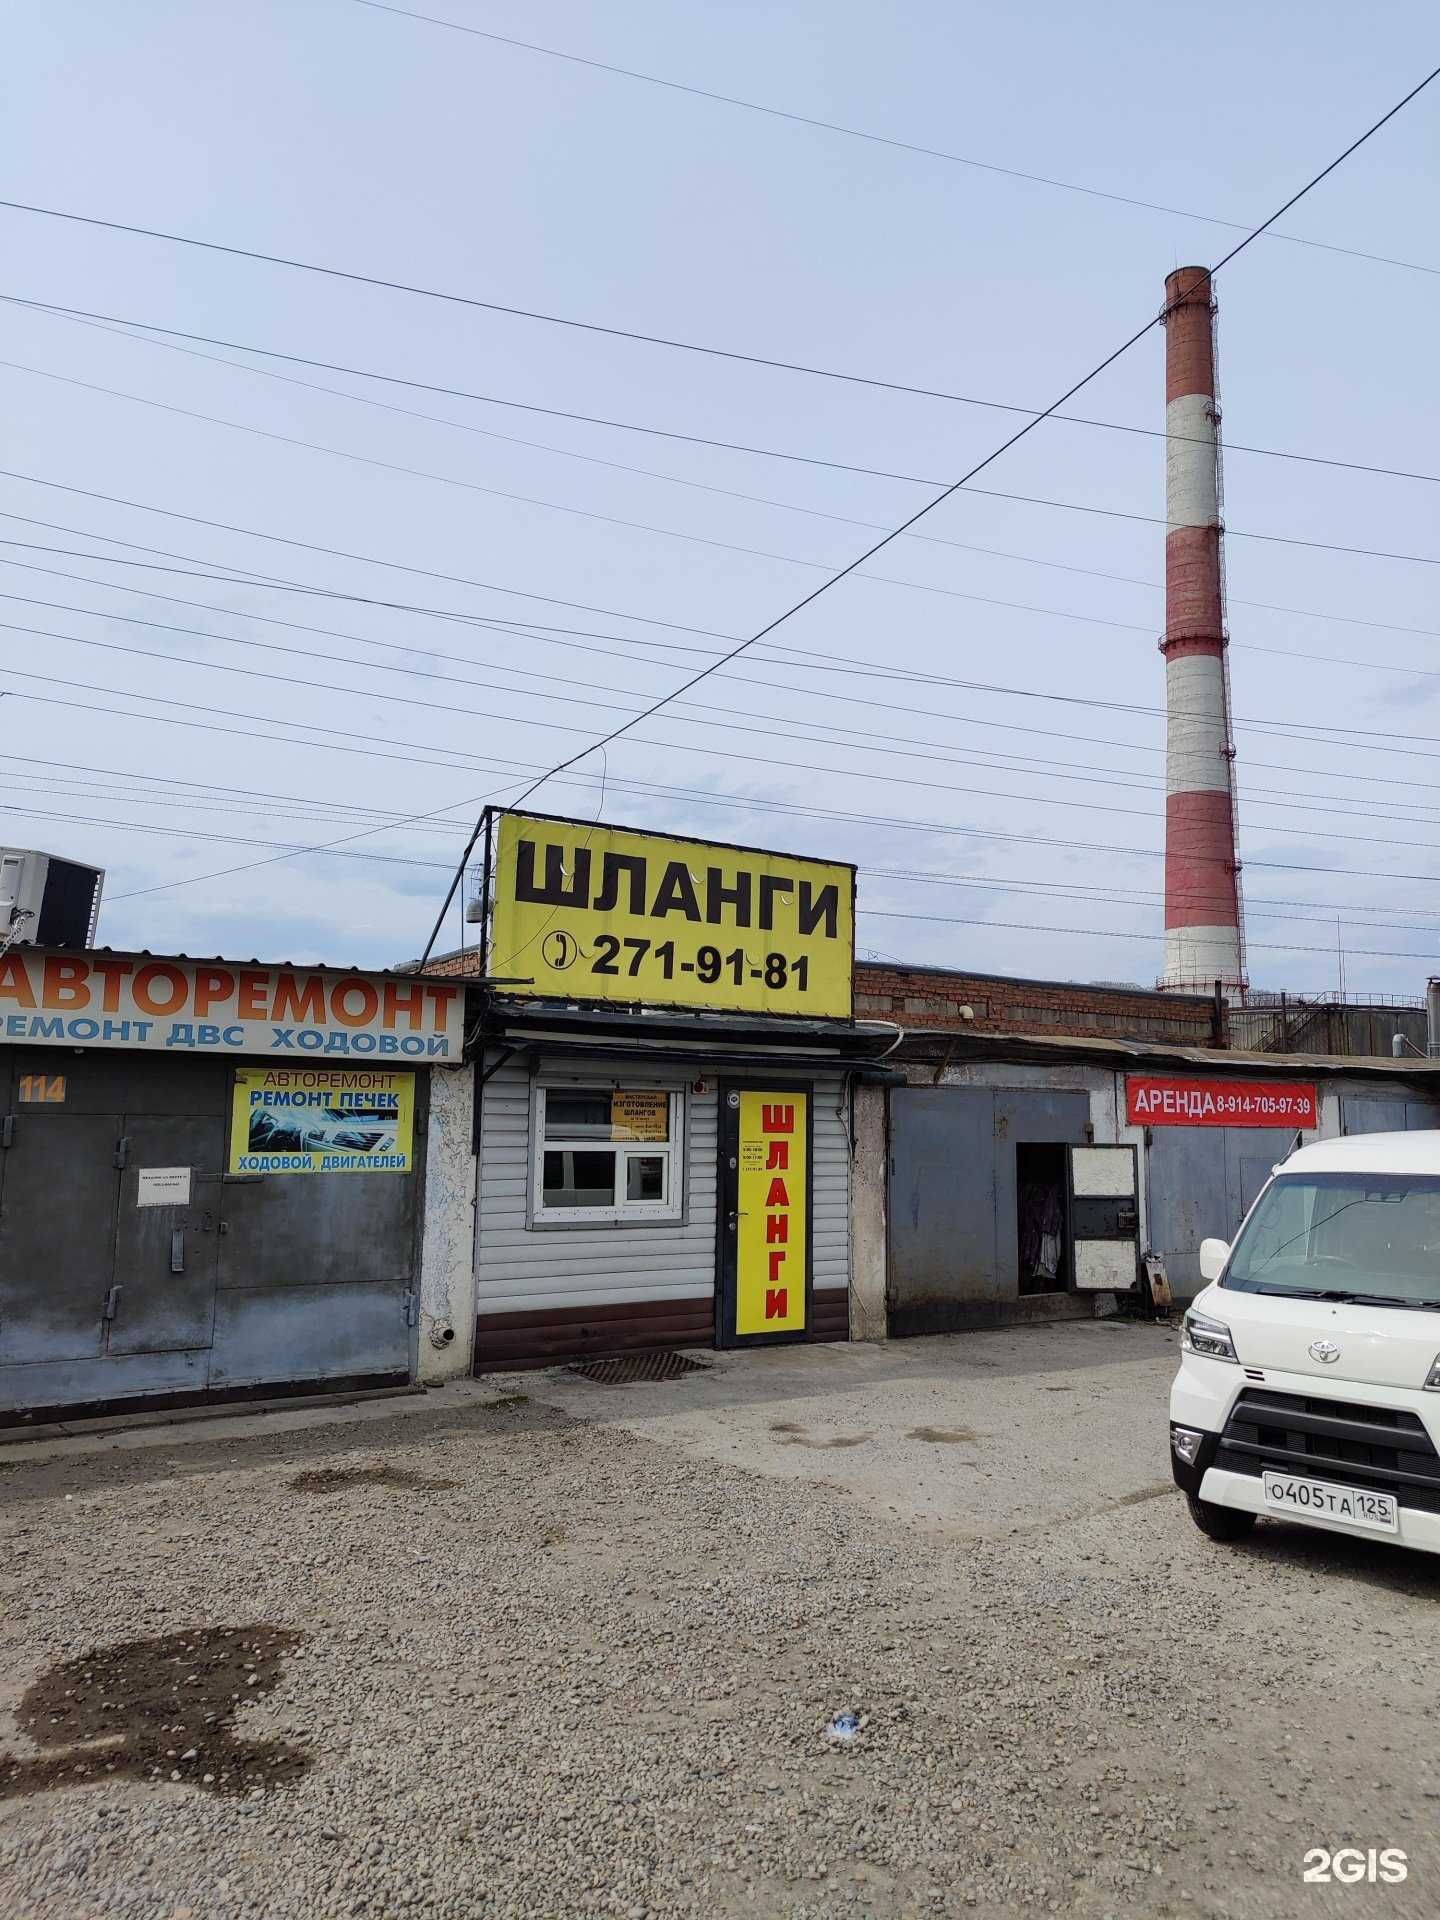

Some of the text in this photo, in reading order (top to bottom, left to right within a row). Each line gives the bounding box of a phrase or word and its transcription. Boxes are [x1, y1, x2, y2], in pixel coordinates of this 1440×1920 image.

[515, 840, 839, 938] ШЛАНГИ
[591, 935, 809, 992] 271-91-81
[0, 953, 457, 1032] АВТОРЕМОНТ
[0, 1015, 449, 1057] ЕМОНТ ДВС ХОДОВОЙ
[20, 1075, 65, 1102] 114
[263, 1072, 396, 1089] АВТОРЕМОНТ
[250, 1090, 399, 1108] РЕМОНТ ПЕЧЕК
[613, 1100, 666, 1109] ИЗГОТОВЛЕНИЕ
[1135, 1088, 1311, 1118] АРЕНДА 8-914-705-97-39
[623, 1108, 656, 1117] ШЛАНГОВ
[238, 1153, 406, 1172] ХОДОВОЙ, ДВИГАТЕЛЕЙ
[762, 1104, 794, 1320] ШЛАНГИ
[1356, 1496, 1388, 1516] 125
[1363, 1512, 1379, 1521] RUS
